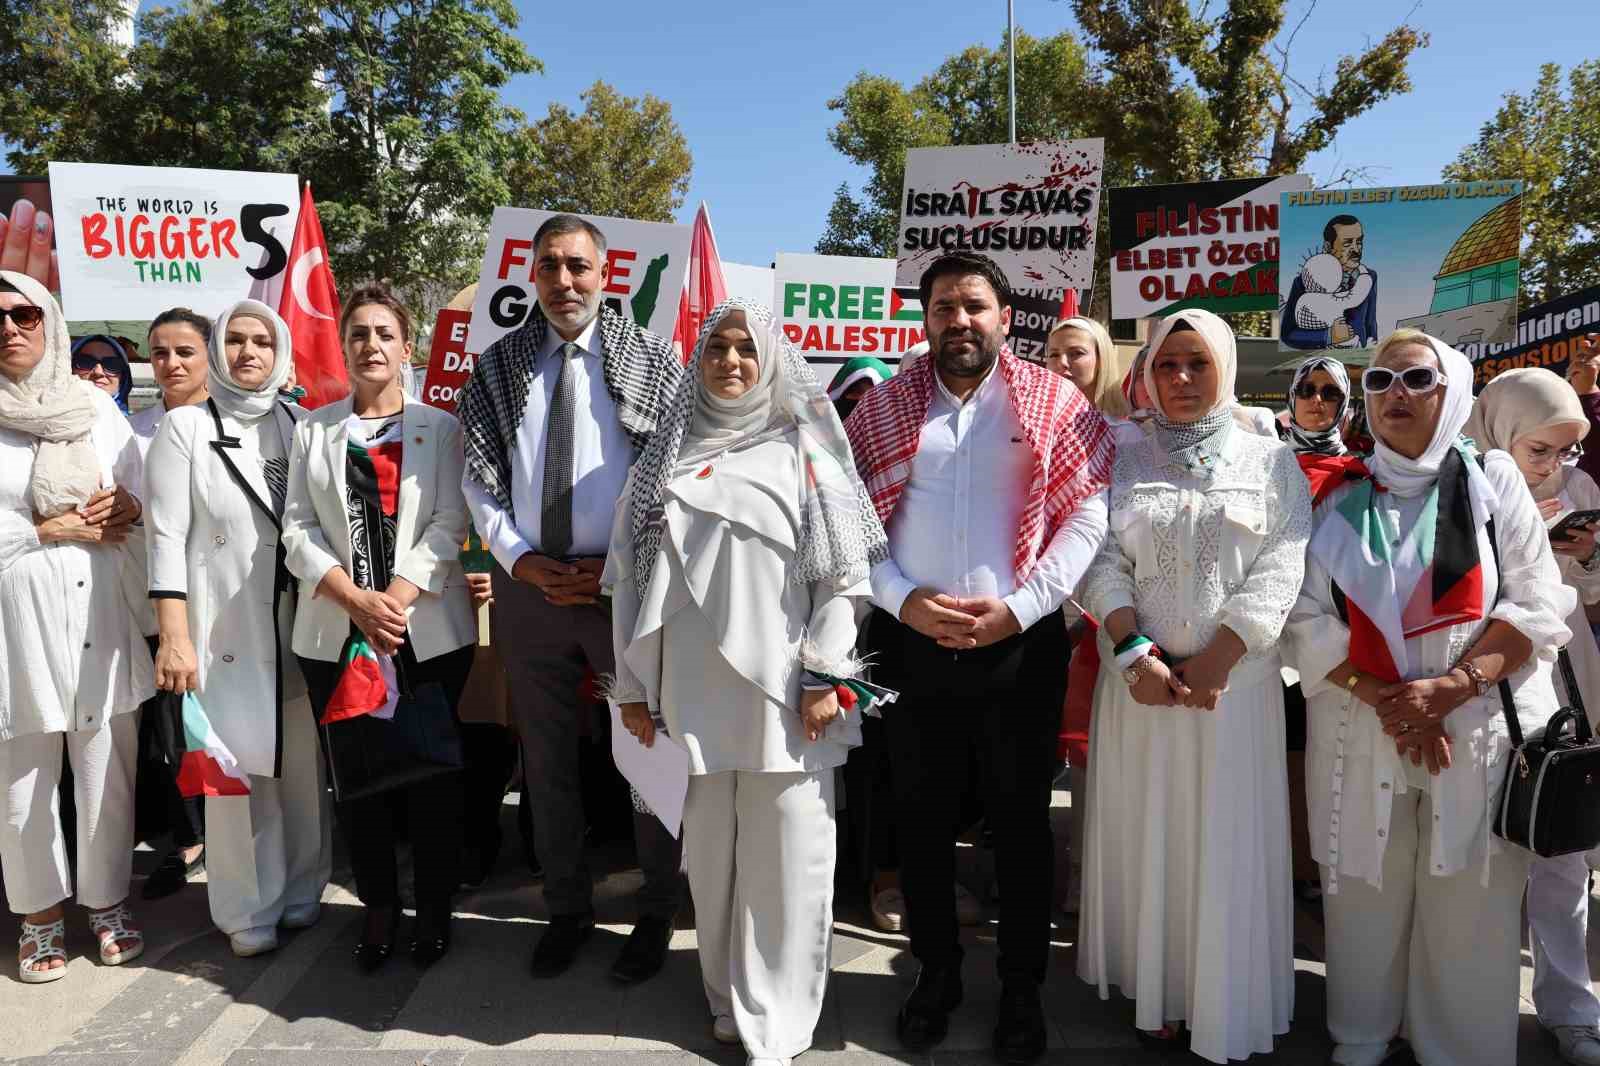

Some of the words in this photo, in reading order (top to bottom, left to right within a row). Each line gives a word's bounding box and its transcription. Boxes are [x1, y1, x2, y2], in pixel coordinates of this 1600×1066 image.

[96, 196, 127, 212] THE
[137, 198, 193, 215] WORLD
[204, 200, 218, 215] IS
[1000, 187, 1093, 217] SAVAŞ
[81, 213, 240, 260] BIGGER
[240, 203, 290, 280] 5
[134, 261, 202, 282] THAN
[497, 238, 638, 294] FE
[1116, 247, 1200, 272] ELBET
[784, 283, 884, 320] FREE
[1139, 270, 1279, 302] OLACAK
